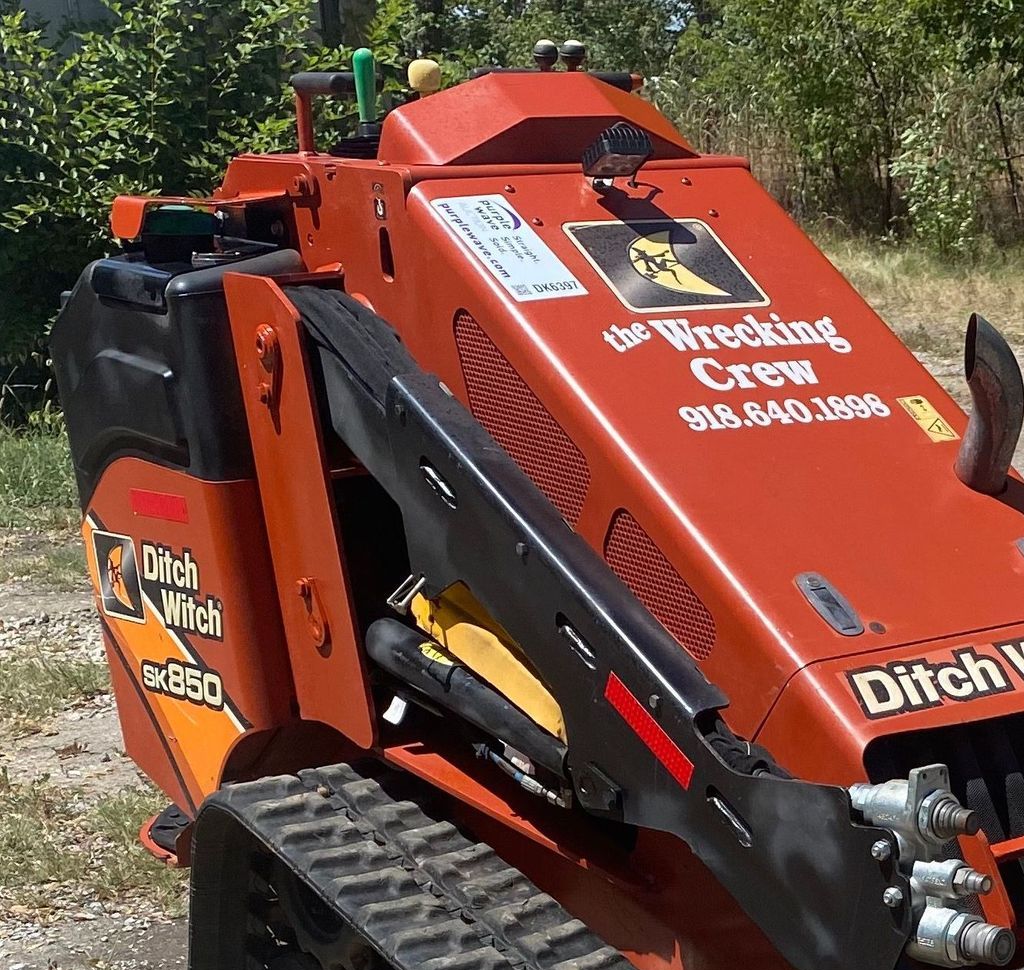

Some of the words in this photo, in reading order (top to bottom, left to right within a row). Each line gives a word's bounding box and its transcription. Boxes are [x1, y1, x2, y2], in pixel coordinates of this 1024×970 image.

[474, 206, 499, 231] wave
[478, 199, 512, 230] purple
[437, 202, 511, 279] purplewave.com
[532, 280, 579, 294] DK6397
[602, 320, 652, 353] the
[647, 312, 853, 354] Wrecking
[689, 356, 820, 392] Crew
[678, 392, 892, 432] 918.640.1898
[142, 543, 199, 591] Ditch
[160, 588, 222, 638] Witch
[142, 661, 223, 707] SK850
[851, 651, 1007, 715] Ditch
